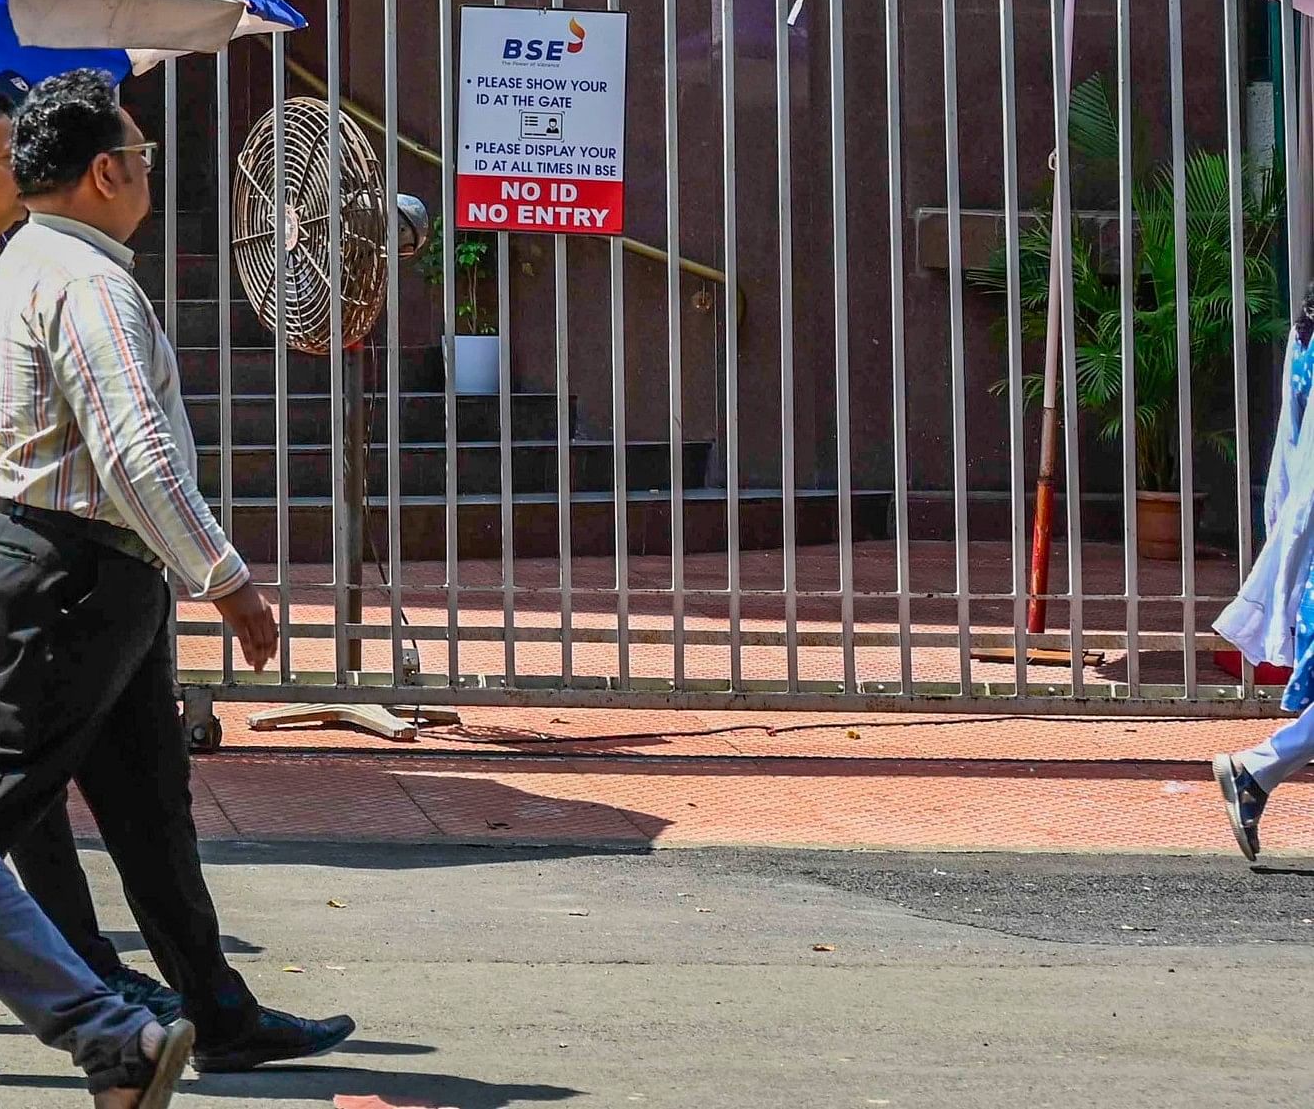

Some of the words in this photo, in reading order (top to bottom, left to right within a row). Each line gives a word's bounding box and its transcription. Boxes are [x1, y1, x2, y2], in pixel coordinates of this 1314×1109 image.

[503, 38, 565, 61] BSE
[477, 76, 523, 89] PLEASE
[526, 78, 567, 91] SHOW
[571, 80, 608, 92] YOUR
[476, 94, 489, 105] ID
[493, 95, 511, 106] AT
[513, 95, 534, 107] THE
[538, 96, 572, 109] GATE
[475, 142, 521, 155] PLEASE
[525, 144, 576, 157] DISPLAY
[579, 146, 617, 159] YOUR
[474, 160, 488, 171] ID
[492, 160, 507, 172] AT
[511, 161, 533, 173] ALL
[537, 162, 573, 174] TIMES
[577, 164, 590, 175] IN
[595, 165, 616, 176] BSE
[501, 181, 541, 200] NO
[550, 183, 578, 202] ID
[468, 203, 508, 223] NO
[517, 205, 610, 227] ENTRY
